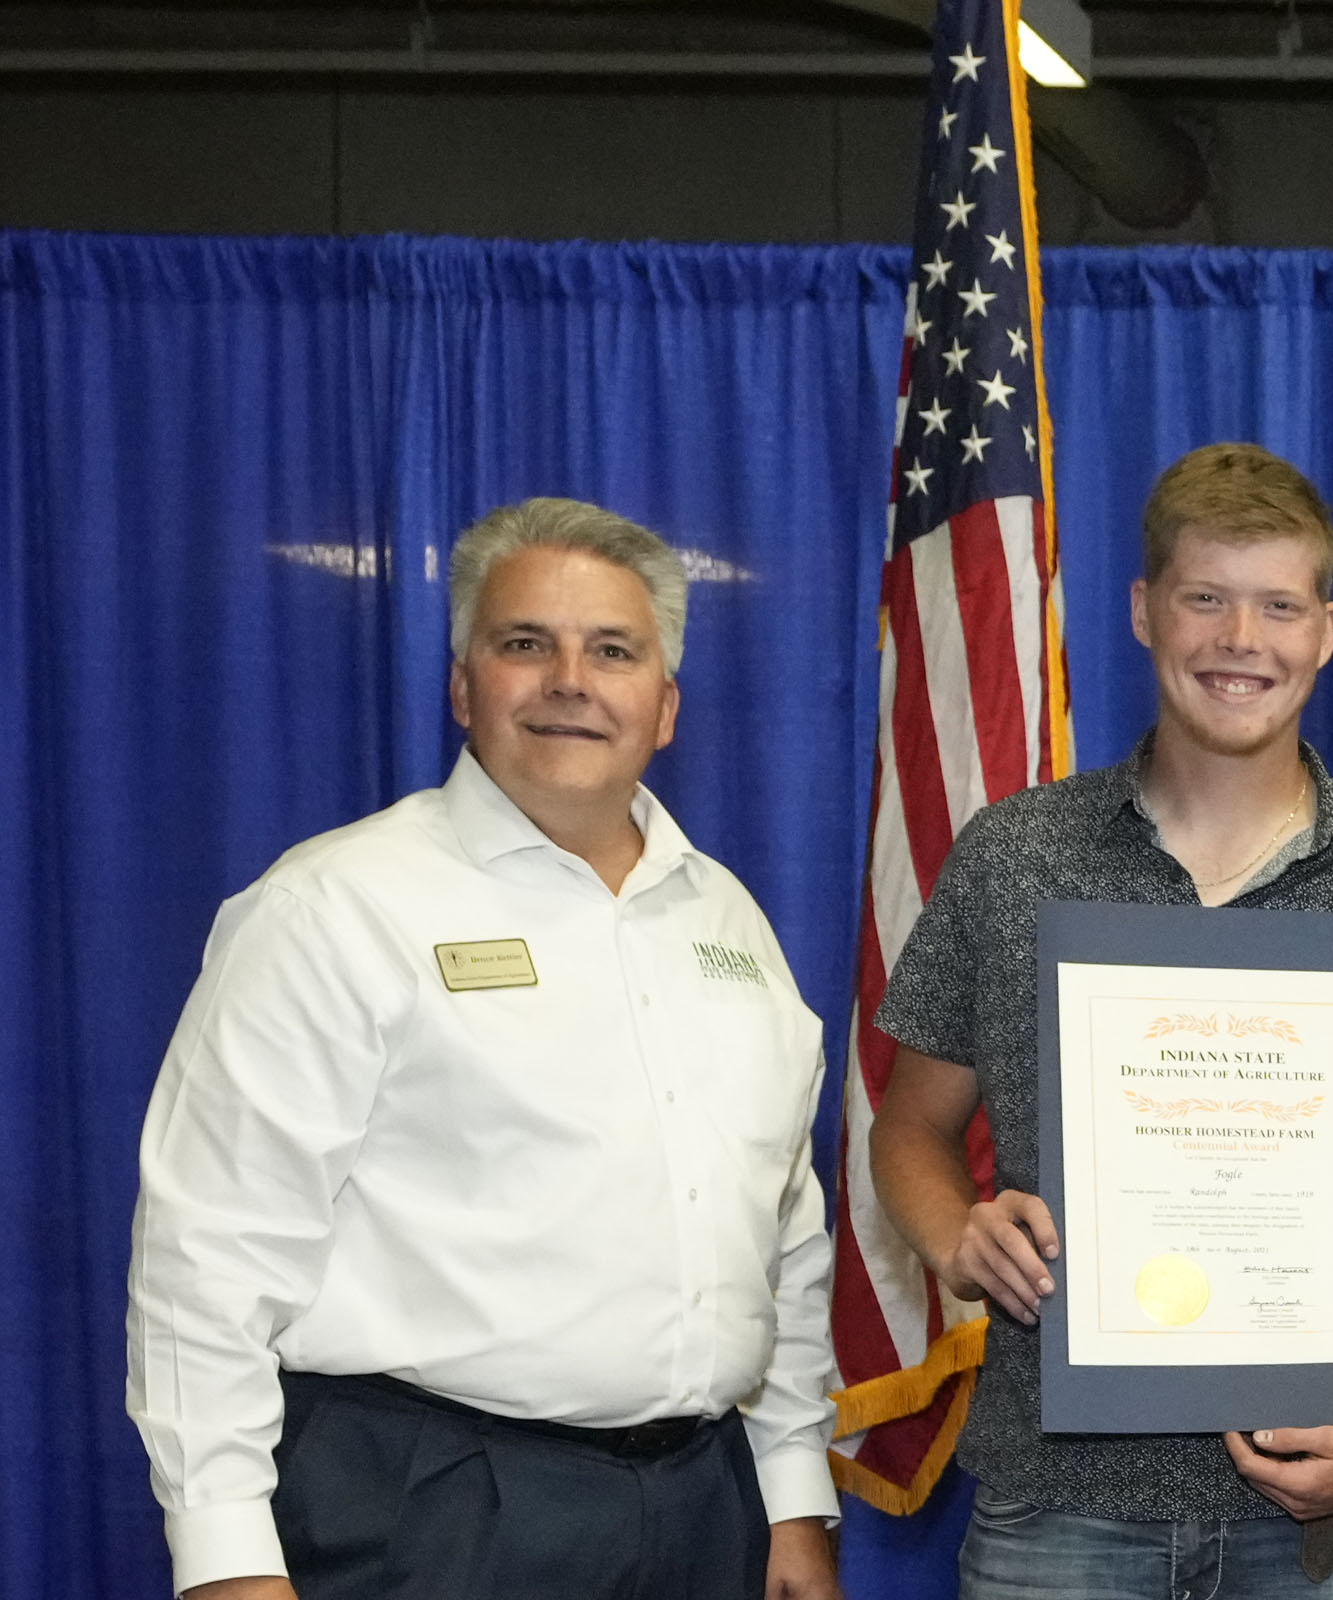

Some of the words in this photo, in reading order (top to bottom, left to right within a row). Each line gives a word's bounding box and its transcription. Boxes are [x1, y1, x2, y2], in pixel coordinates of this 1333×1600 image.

[1160, 1050, 1228, 1063] INDIANA
[1235, 1052, 1286, 1065] STATE
[1121, 1065, 1209, 1079] DEPARTMENT
[1213, 1069, 1229, 1079] OF
[1234, 1068, 1325, 1081] AGRICULTURE
[1135, 1125, 1192, 1136] HOOSIER
[1196, 1127, 1275, 1138] HOMESTEAD
[1279, 1129, 1314, 1139] FARM
[1172, 1140, 1237, 1151] Centennial
[1242, 1141, 1280, 1152] Award
